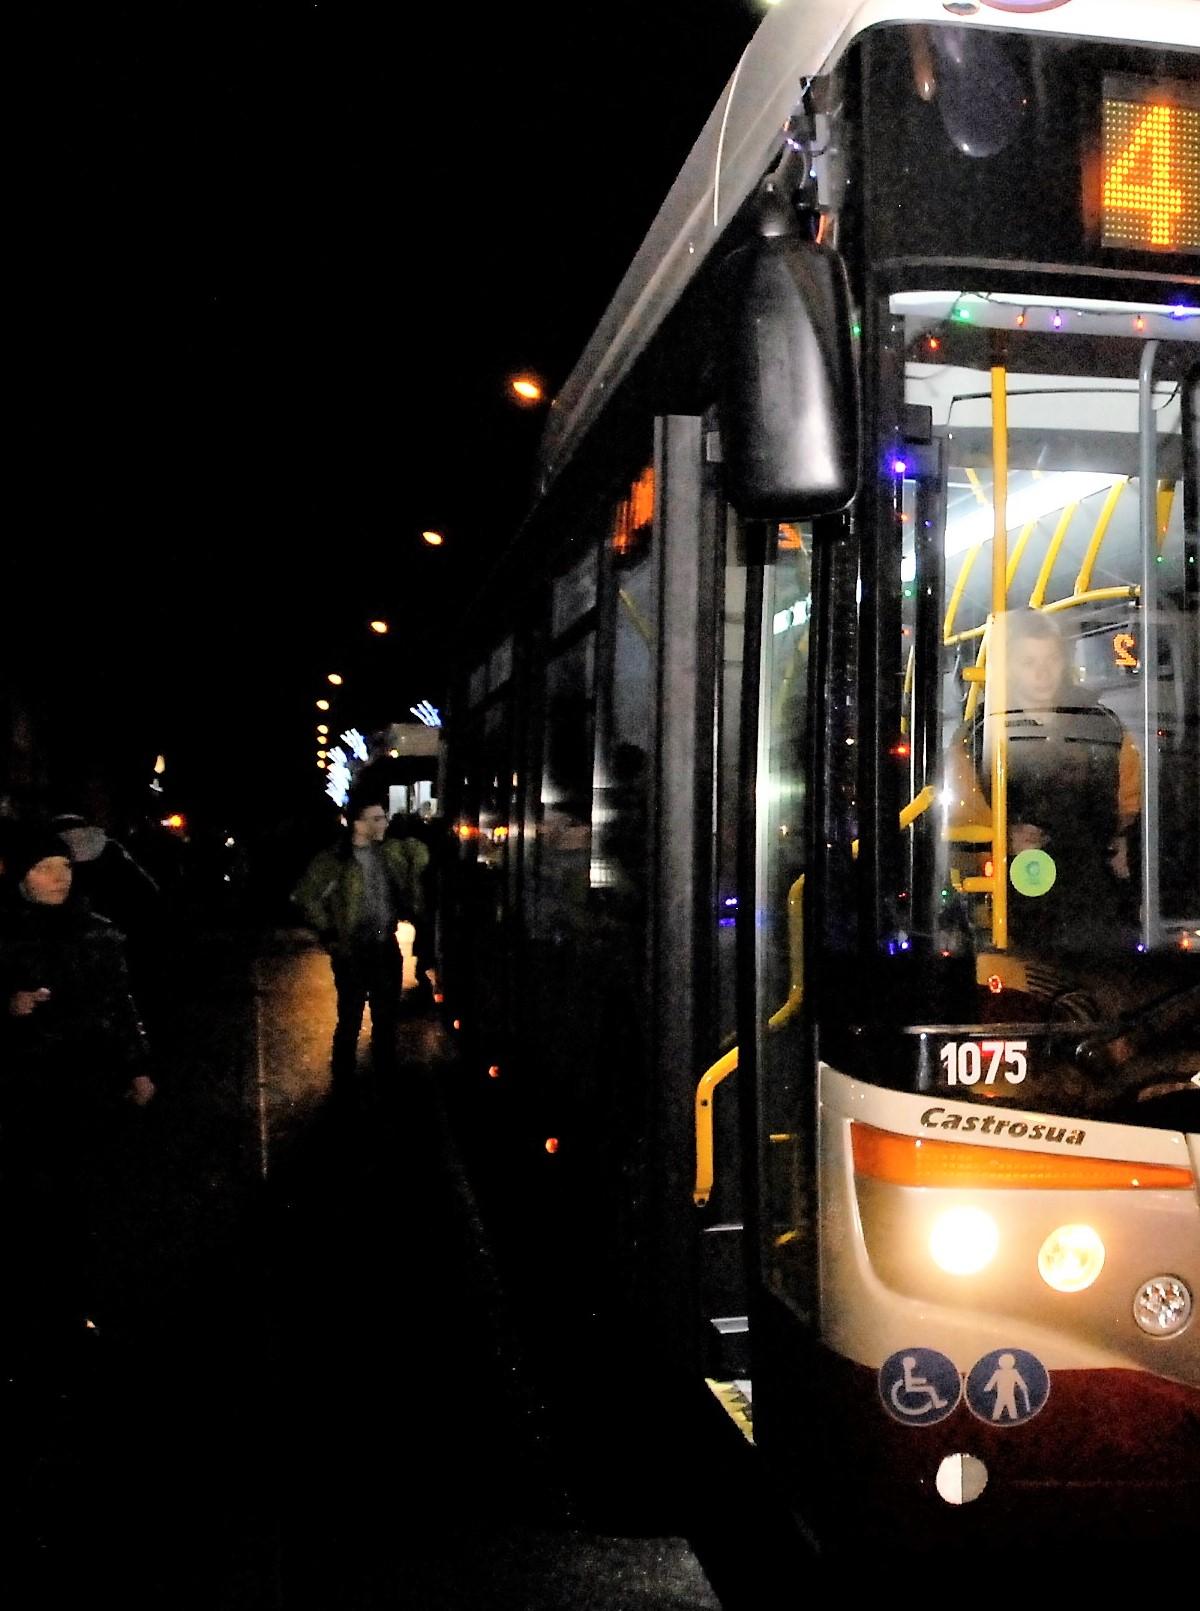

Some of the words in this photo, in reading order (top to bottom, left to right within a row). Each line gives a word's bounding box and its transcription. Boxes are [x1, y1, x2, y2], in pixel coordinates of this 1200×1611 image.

[1103, 103, 1182, 246] 4
[940, 1041, 1028, 1086] 1075
[920, 1107, 1087, 1146] Castrosua
